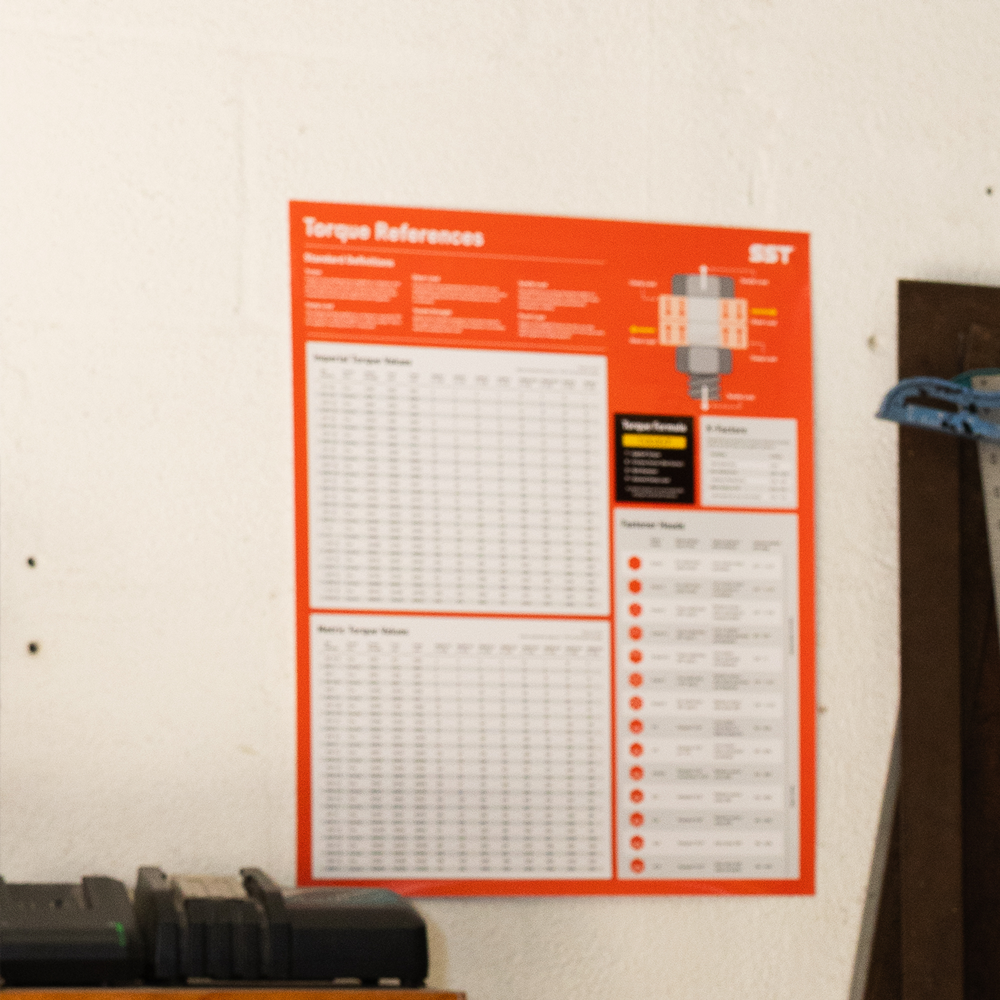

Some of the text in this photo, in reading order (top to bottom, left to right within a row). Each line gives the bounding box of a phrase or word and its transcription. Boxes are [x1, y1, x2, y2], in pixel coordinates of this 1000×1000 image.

[302, 216, 485, 248] Torque References
[748, 243, 795, 265] SST
